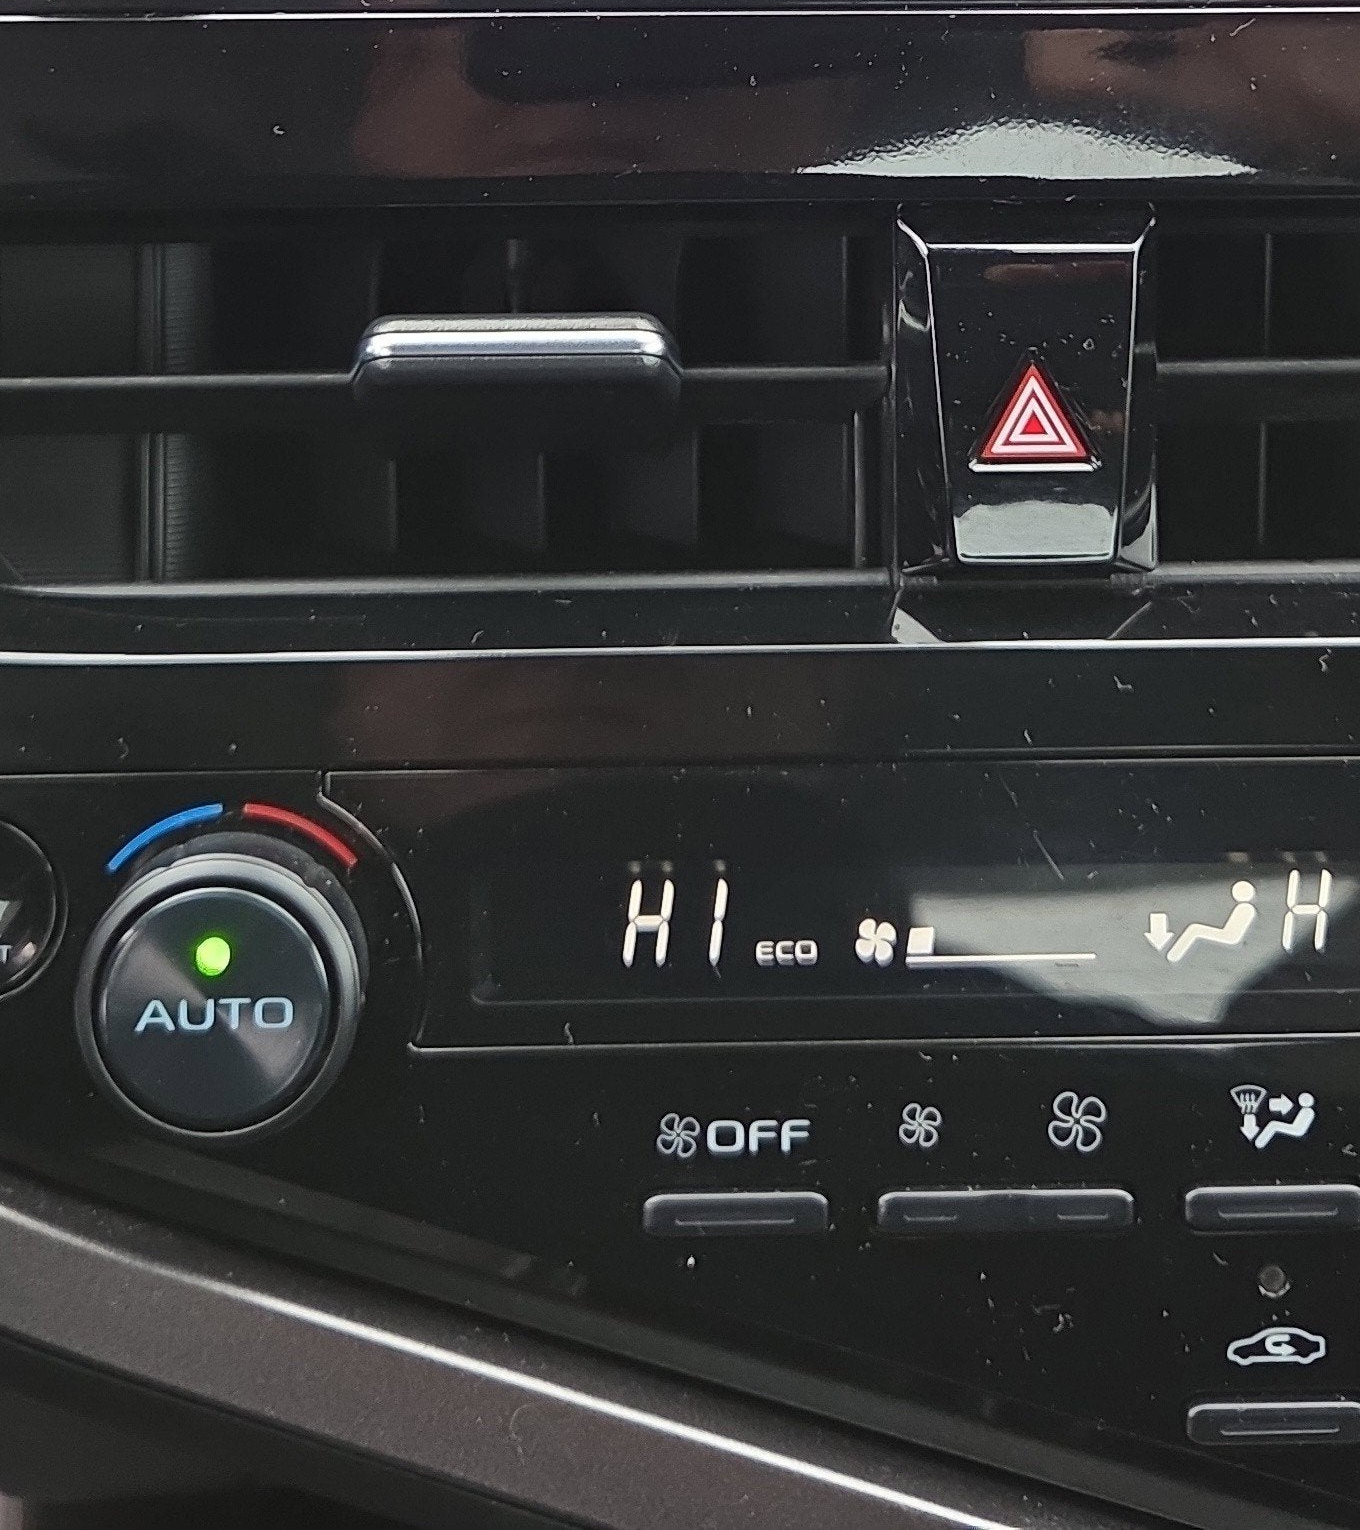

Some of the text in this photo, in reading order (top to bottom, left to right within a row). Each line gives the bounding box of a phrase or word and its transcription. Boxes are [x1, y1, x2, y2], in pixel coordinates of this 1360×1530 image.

[755, 939, 819, 965] ECO
[134, 997, 295, 1032] AUTO
[705, 1117, 811, 1155] OFF
